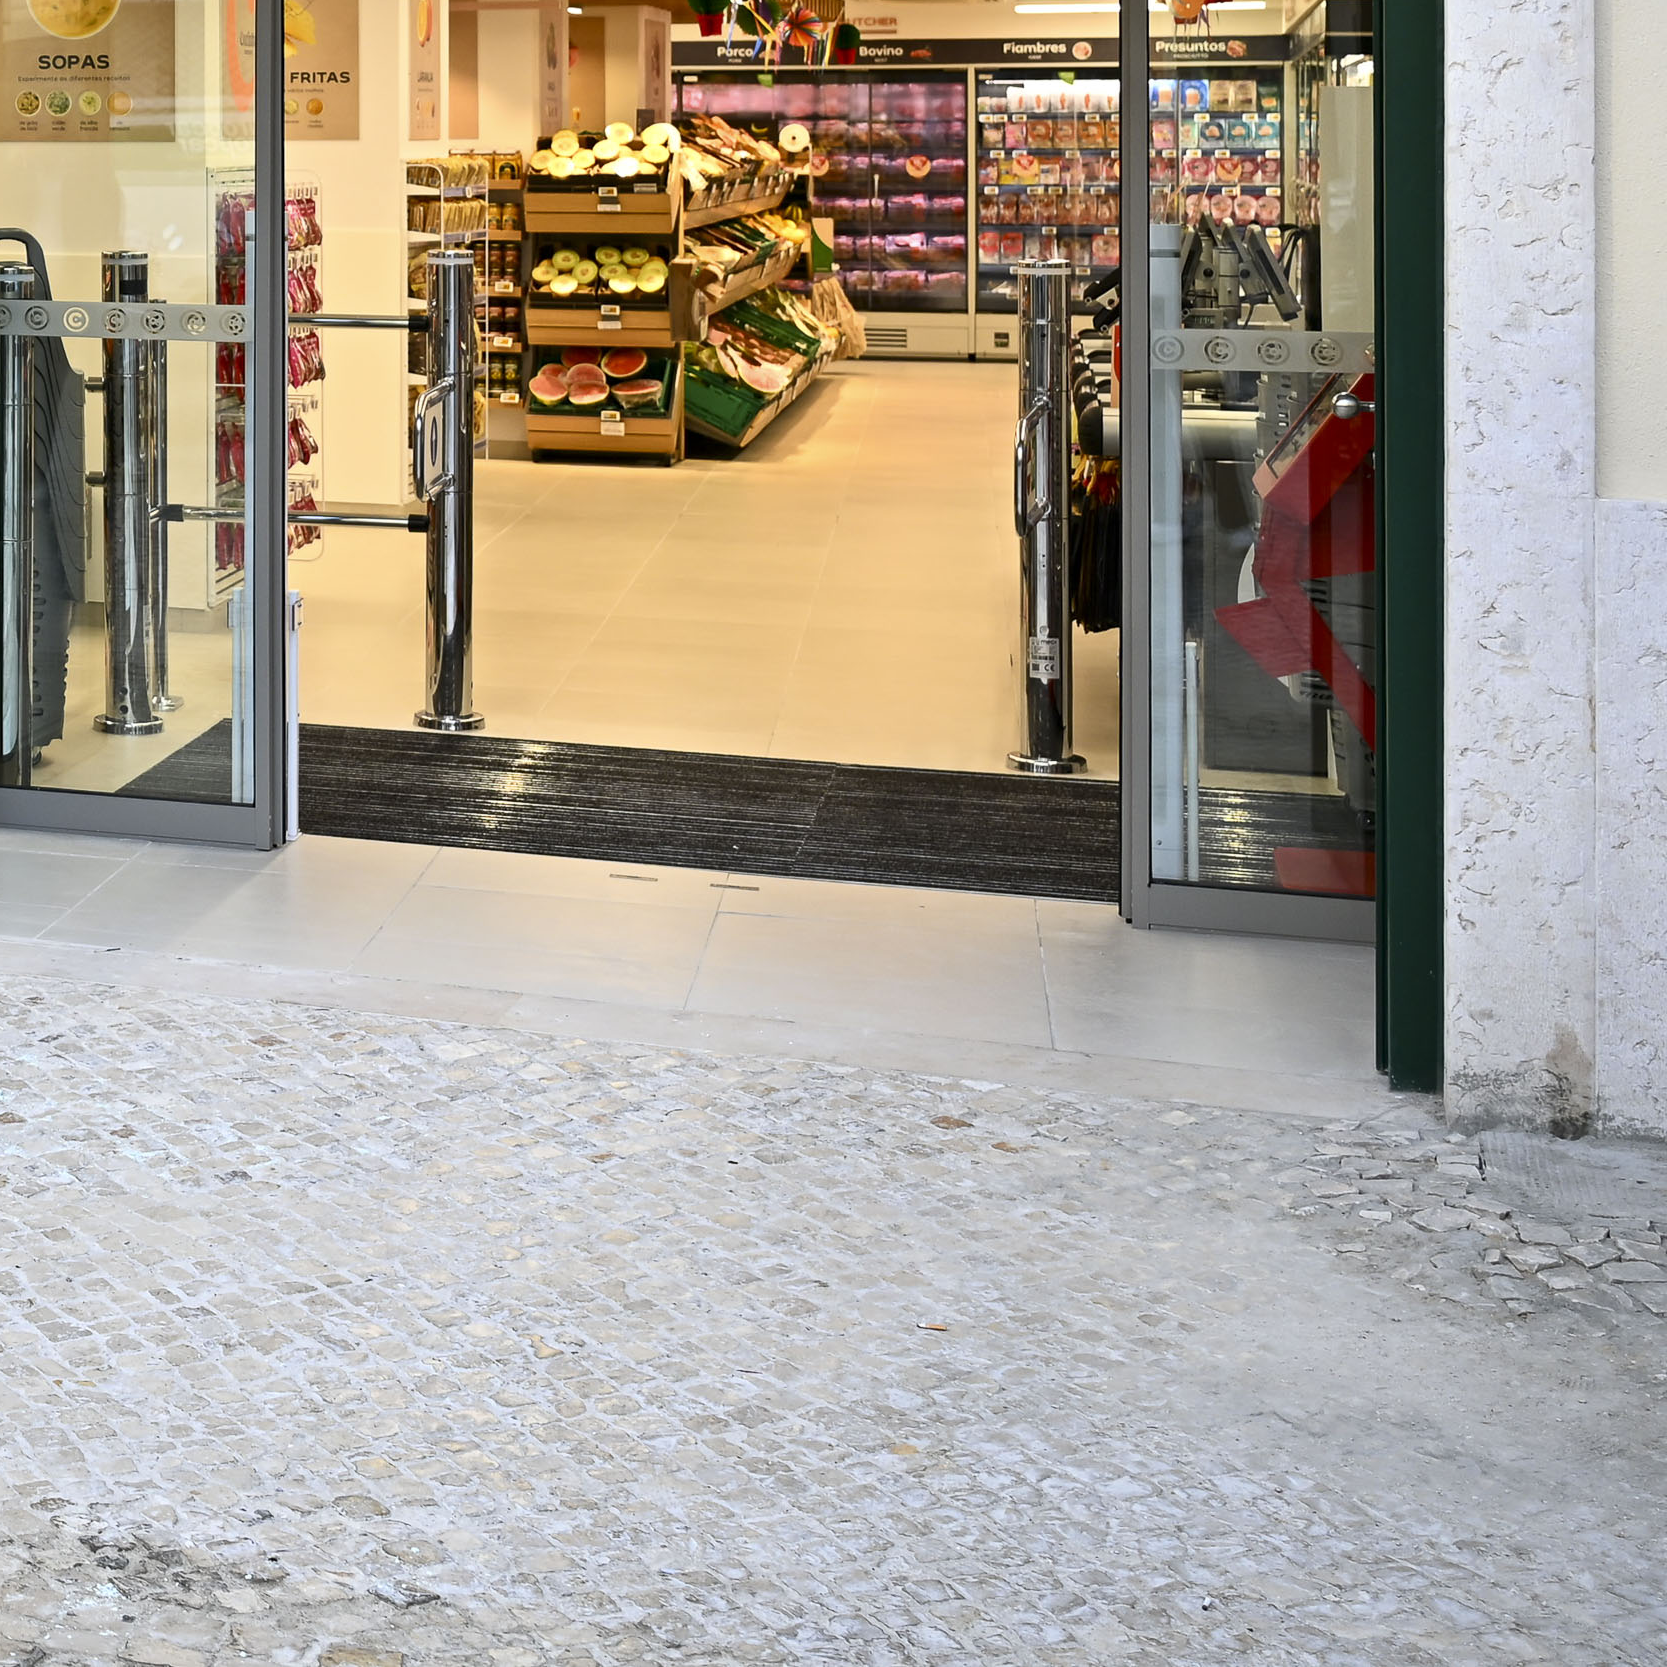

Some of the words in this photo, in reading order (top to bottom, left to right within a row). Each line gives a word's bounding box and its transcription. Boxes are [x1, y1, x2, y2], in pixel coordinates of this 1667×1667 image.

[717, 46, 754, 58] Porco
[859, 44, 904, 57] Bovino
[1002, 40, 1067, 54] Fiambres
[1155, 40, 1227, 53] Presuntos
[38, 54, 110, 70] SOPAS
[289, 71, 351, 84] FRITAS
